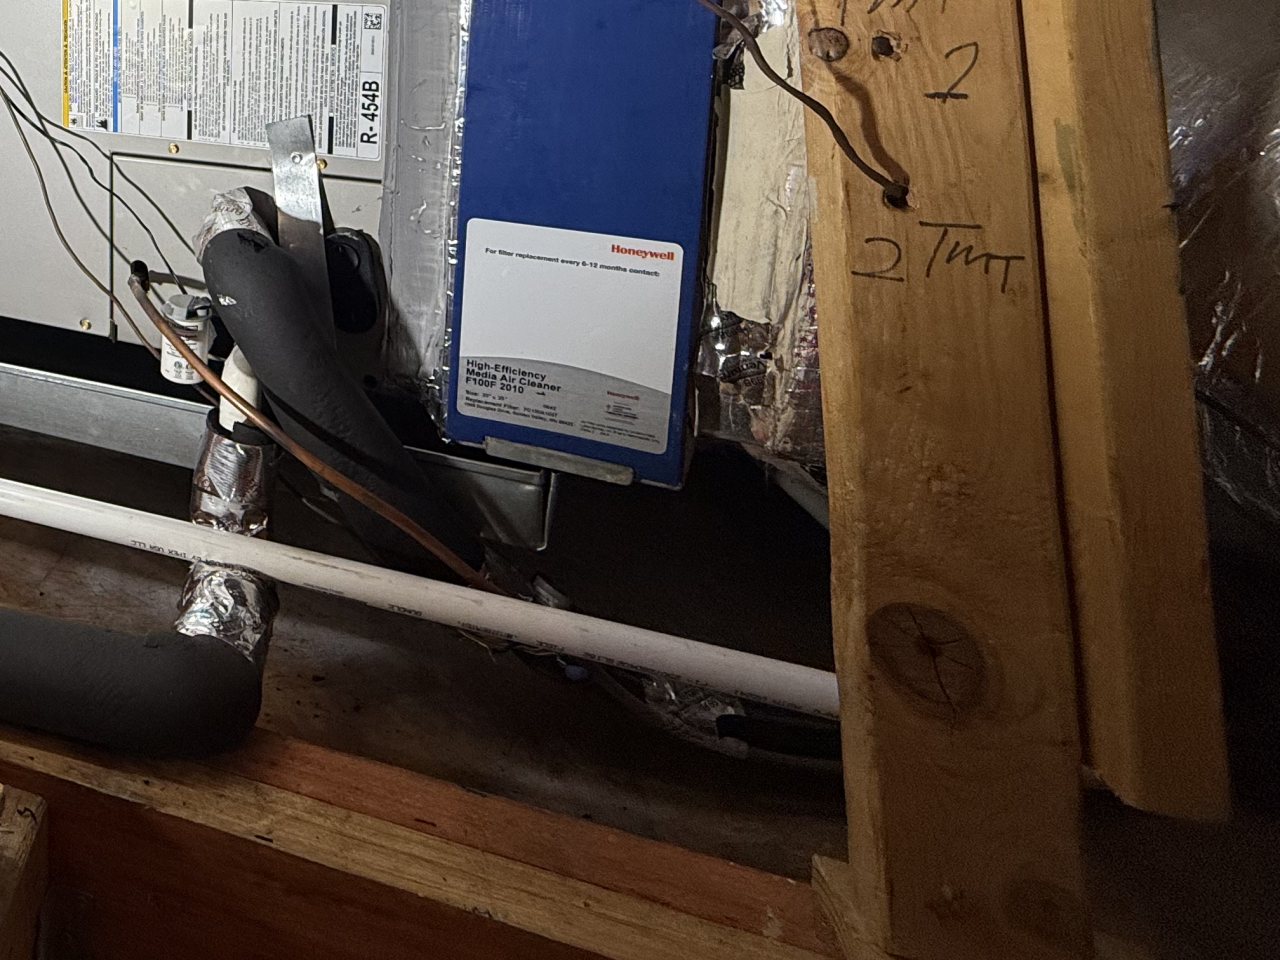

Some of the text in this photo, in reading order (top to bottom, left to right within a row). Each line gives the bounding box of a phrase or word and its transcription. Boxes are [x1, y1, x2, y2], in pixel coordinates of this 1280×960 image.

[360, 80, 380, 122] 454B
[485, 247, 497, 255] For
[498, 249, 514, 257] filter
[515, 252, 559, 264] replacement
[560, 259, 580, 267] every
[581, 260, 598, 269] 6-12
[599, 263, 628, 273] months
[611, 244, 675, 261] Honeywell
[466, 368, 562, 392] Media Air Cleaner
[467, 358, 547, 382] High-Efficiency
[466, 376, 525, 394] F100F 2010
